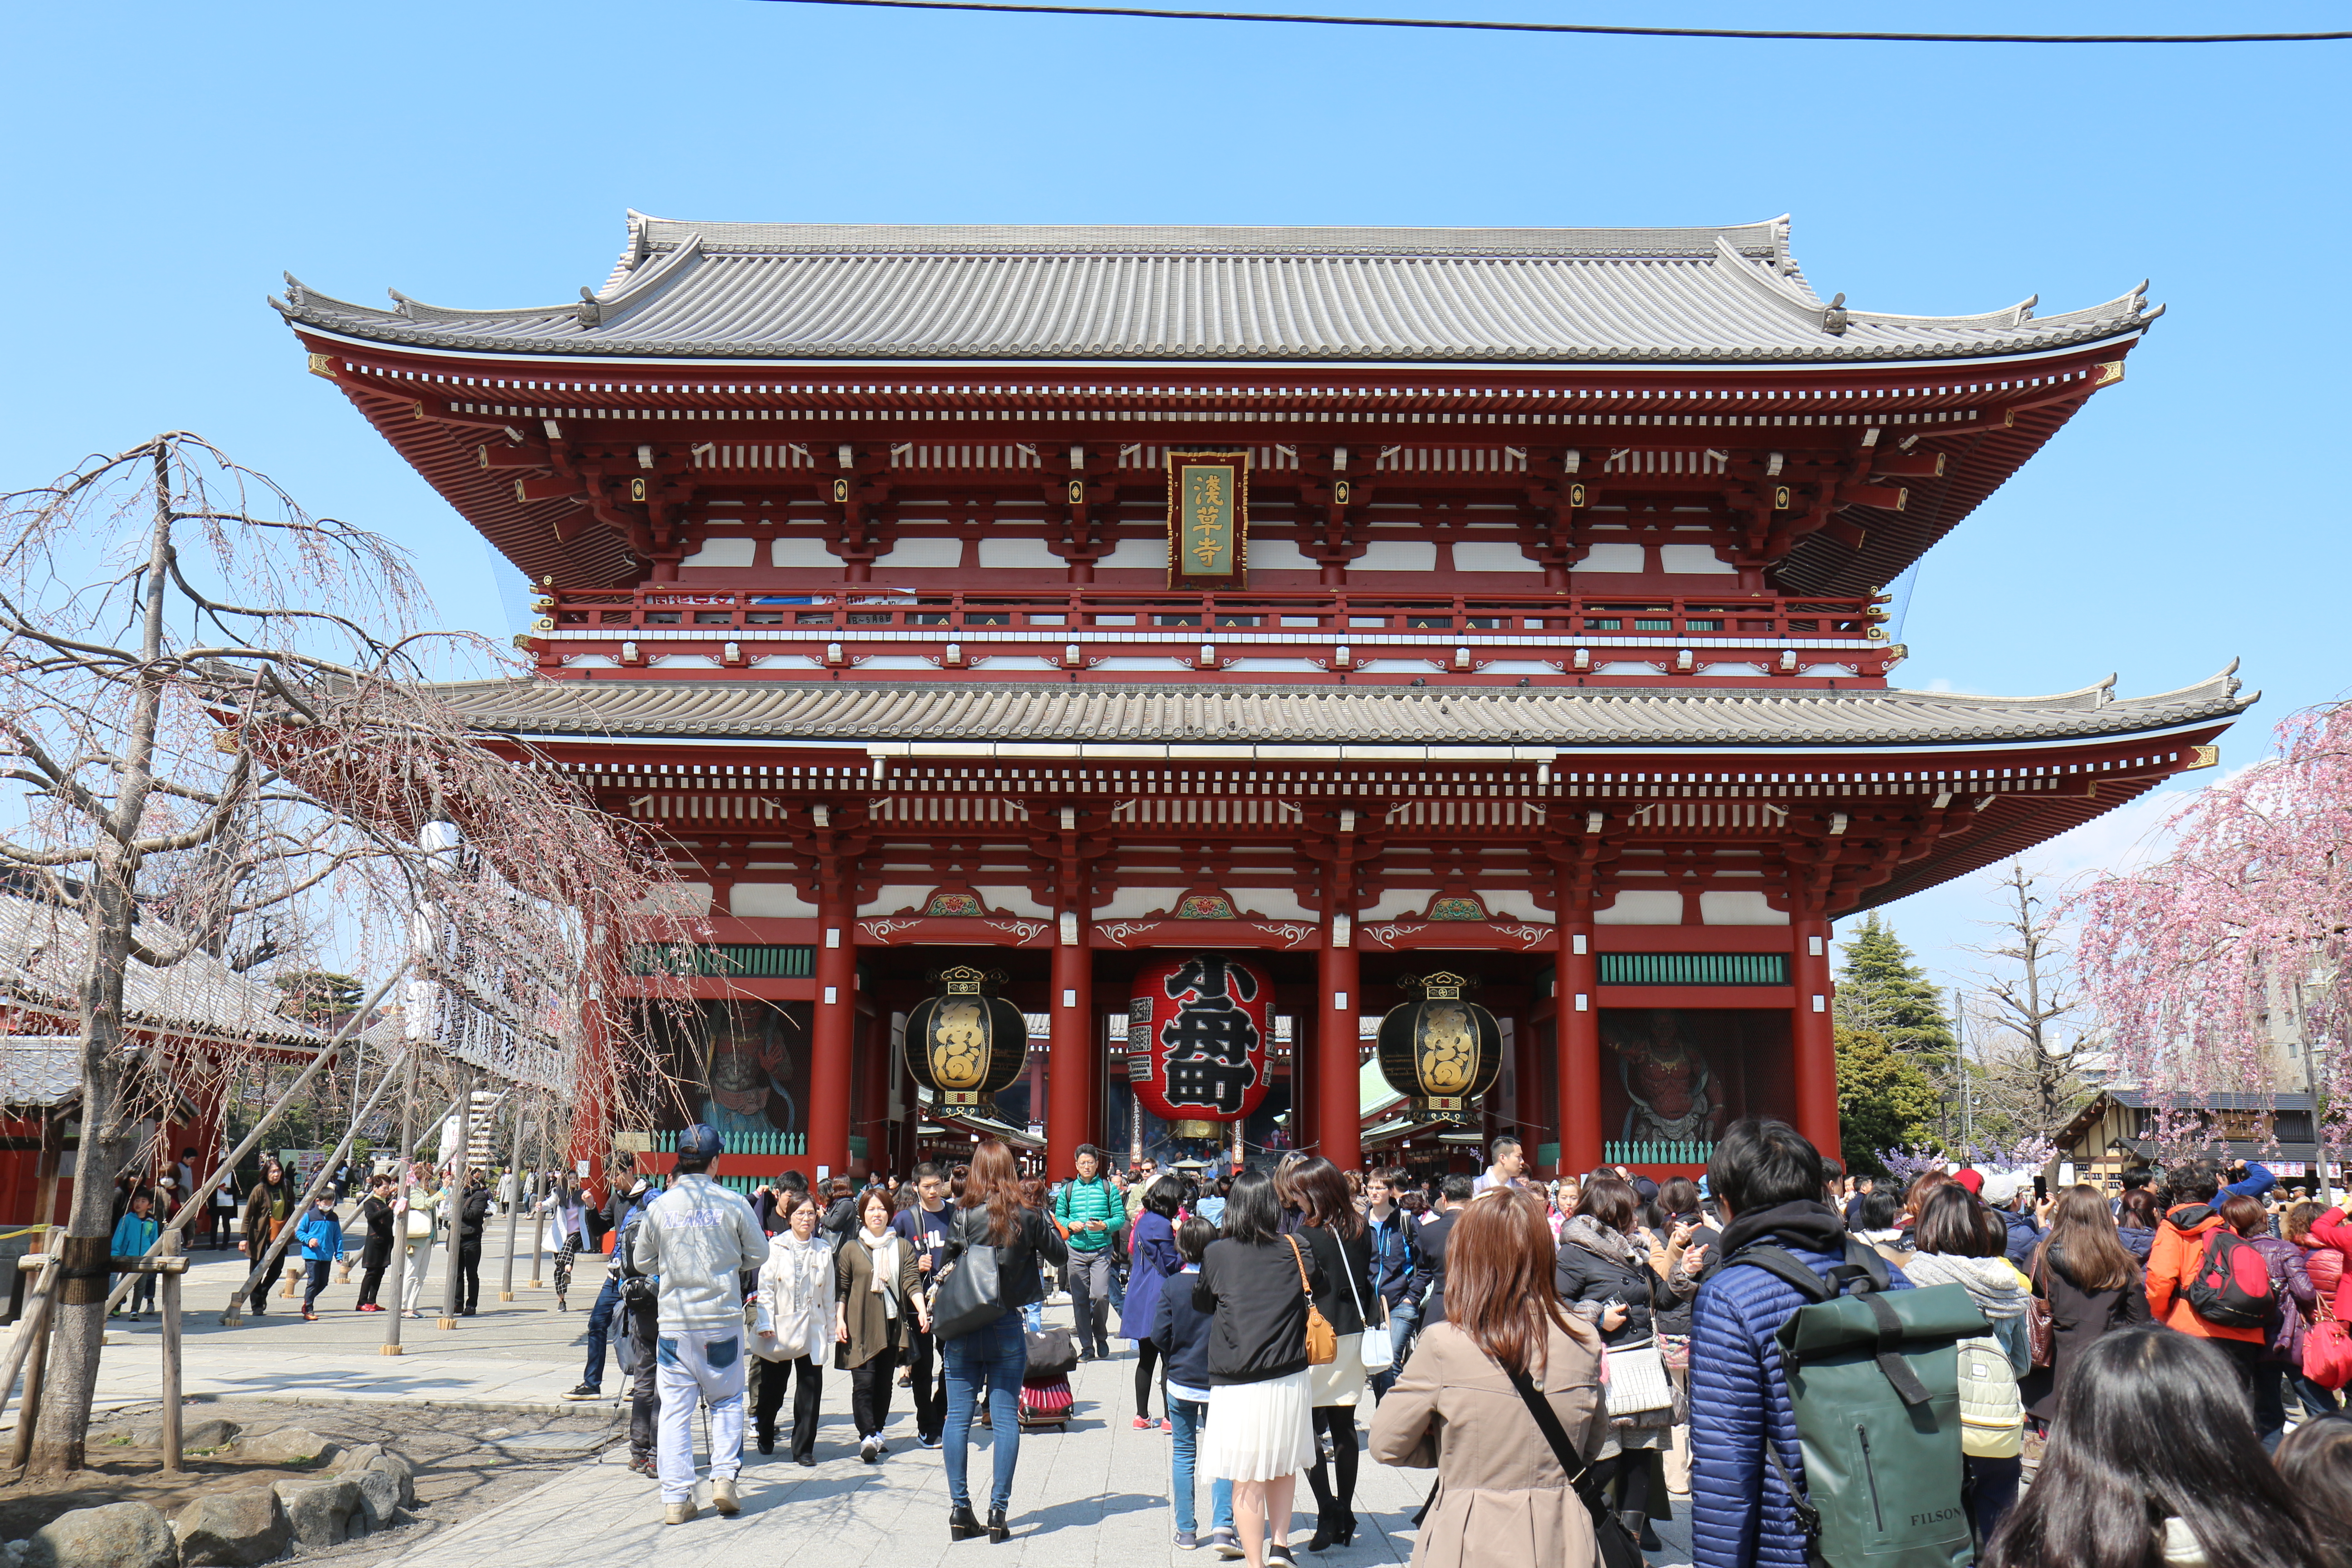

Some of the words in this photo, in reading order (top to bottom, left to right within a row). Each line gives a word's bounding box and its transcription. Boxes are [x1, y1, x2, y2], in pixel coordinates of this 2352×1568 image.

[1160, 954, 1260, 1114] 小舟町
[662, 1209, 724, 1229] XLARGE
[1910, 1506, 1965, 1526] FILSON
